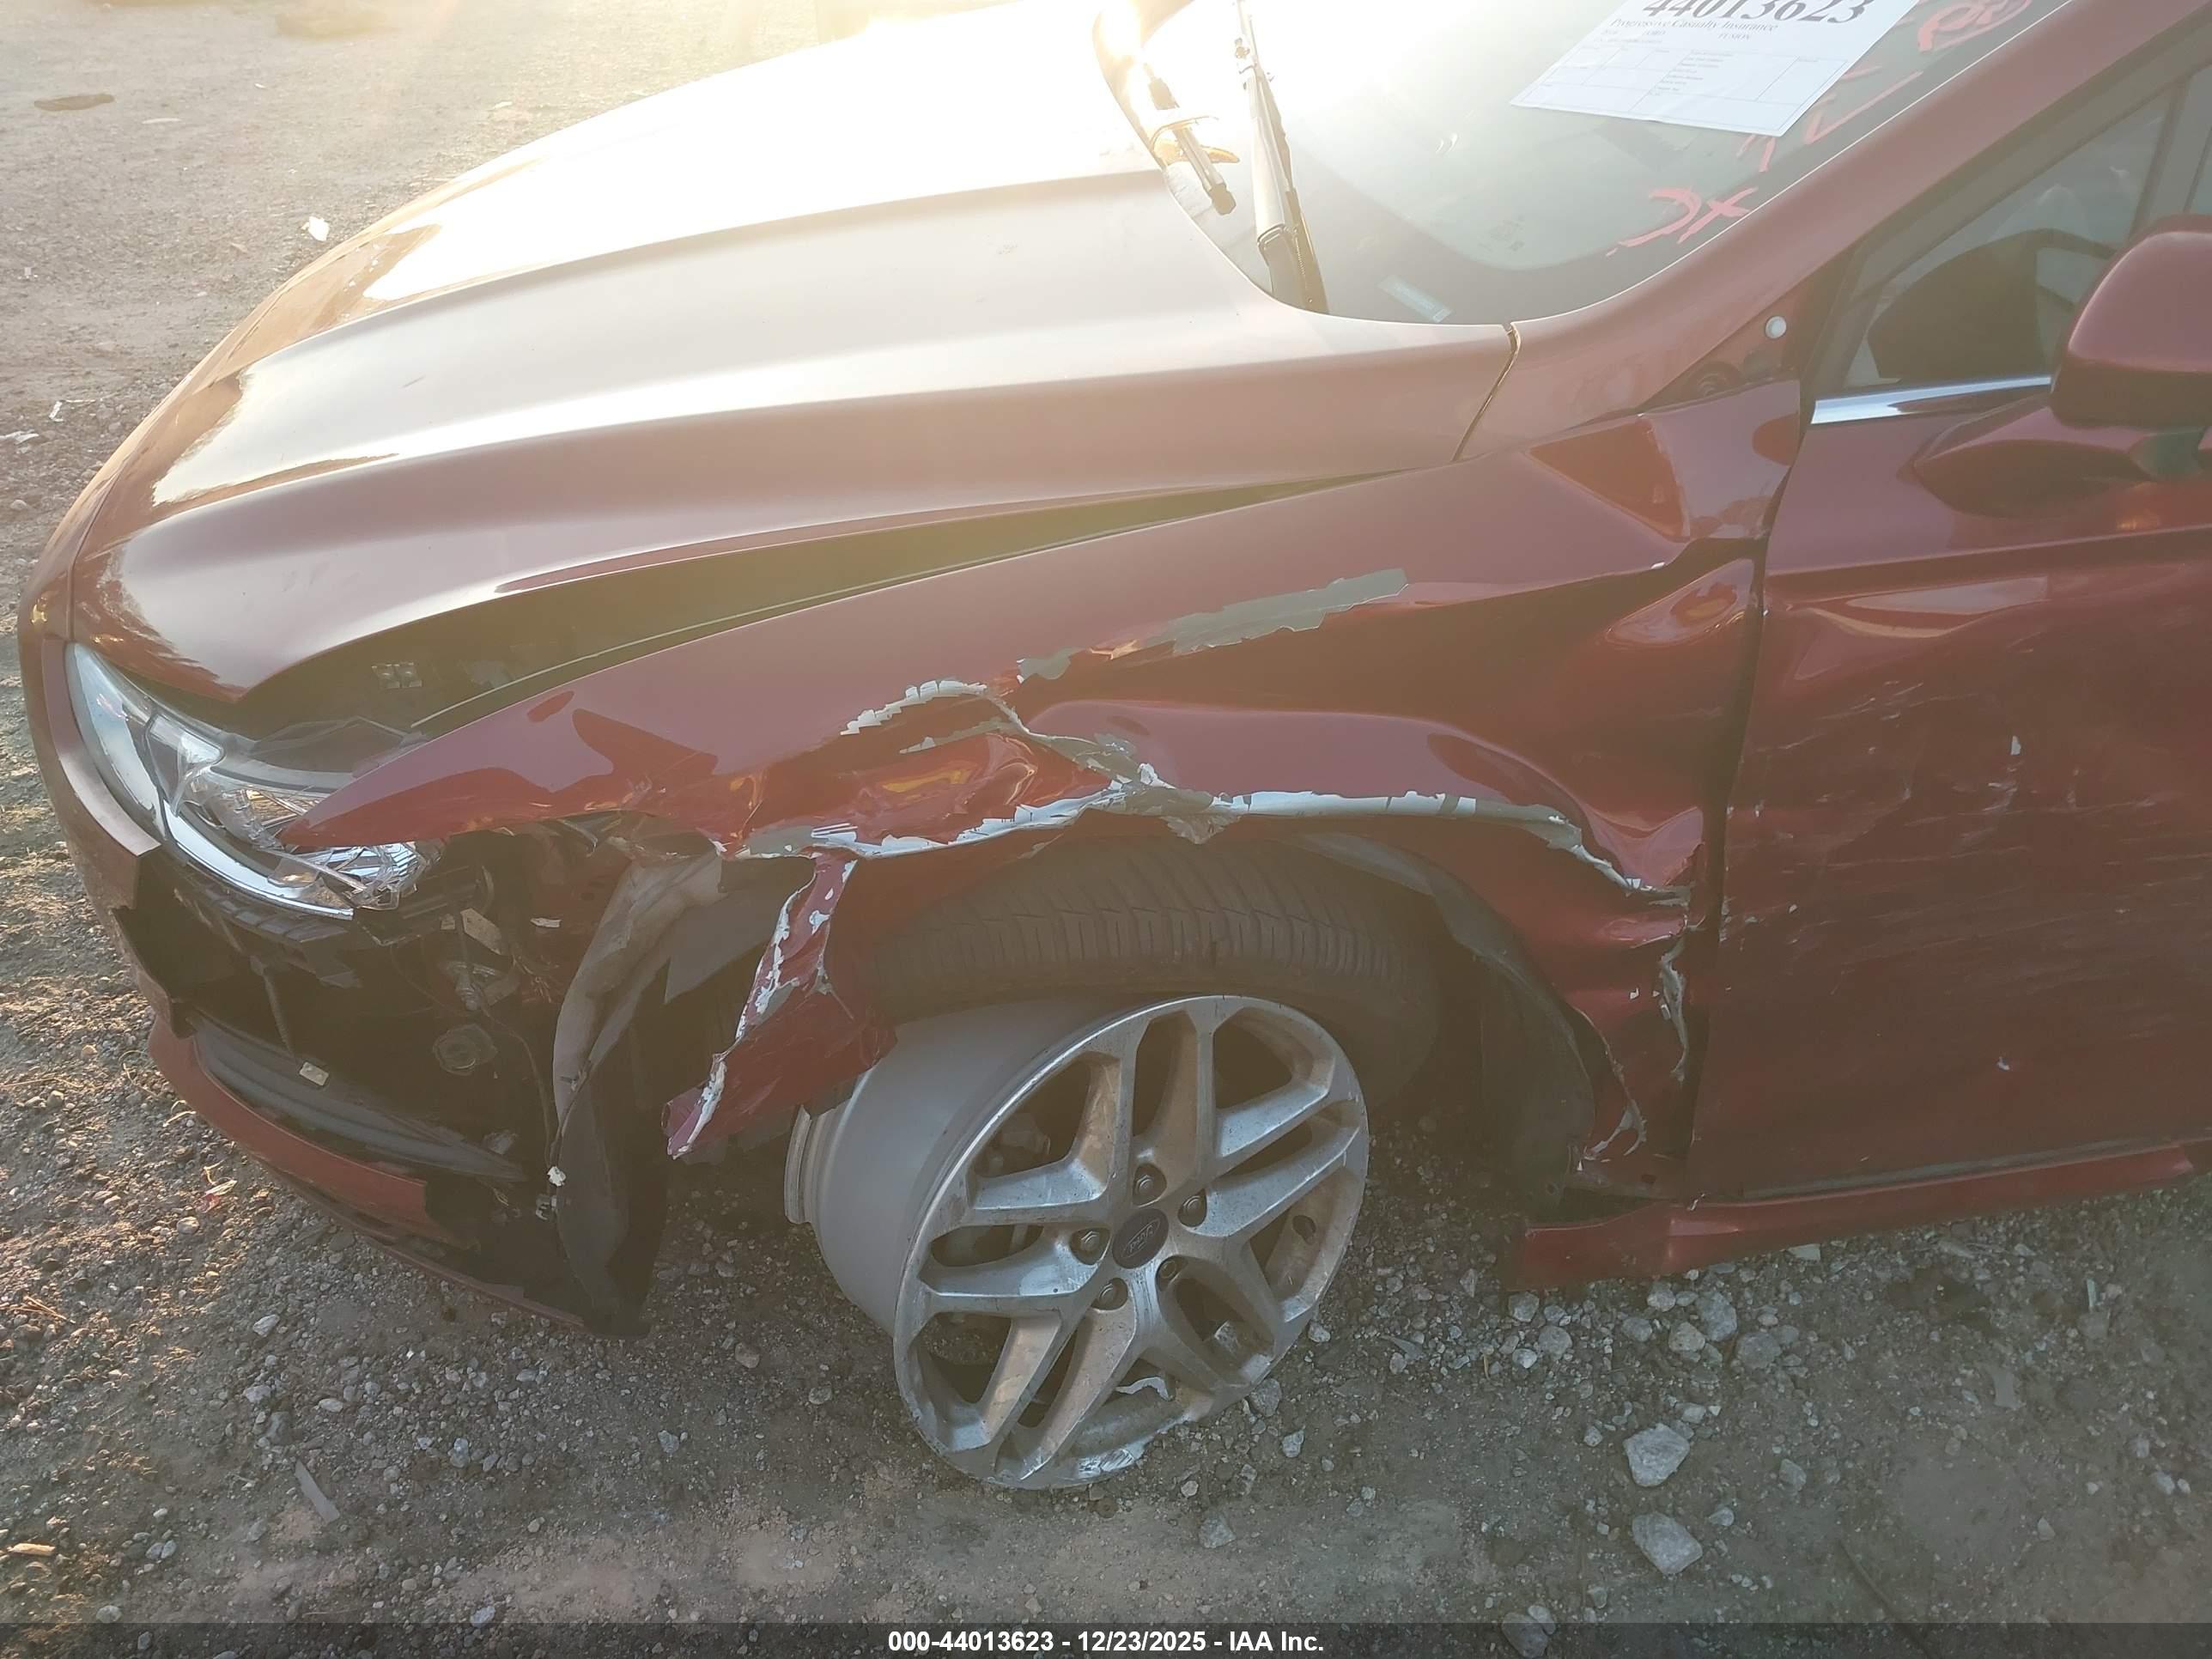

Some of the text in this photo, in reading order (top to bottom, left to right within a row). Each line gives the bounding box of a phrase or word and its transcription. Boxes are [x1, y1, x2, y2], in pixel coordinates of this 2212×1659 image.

[1643, 0, 1874, 24] 44013623
[1609, 17, 1779, 32] Progressive Casualty Insurance
